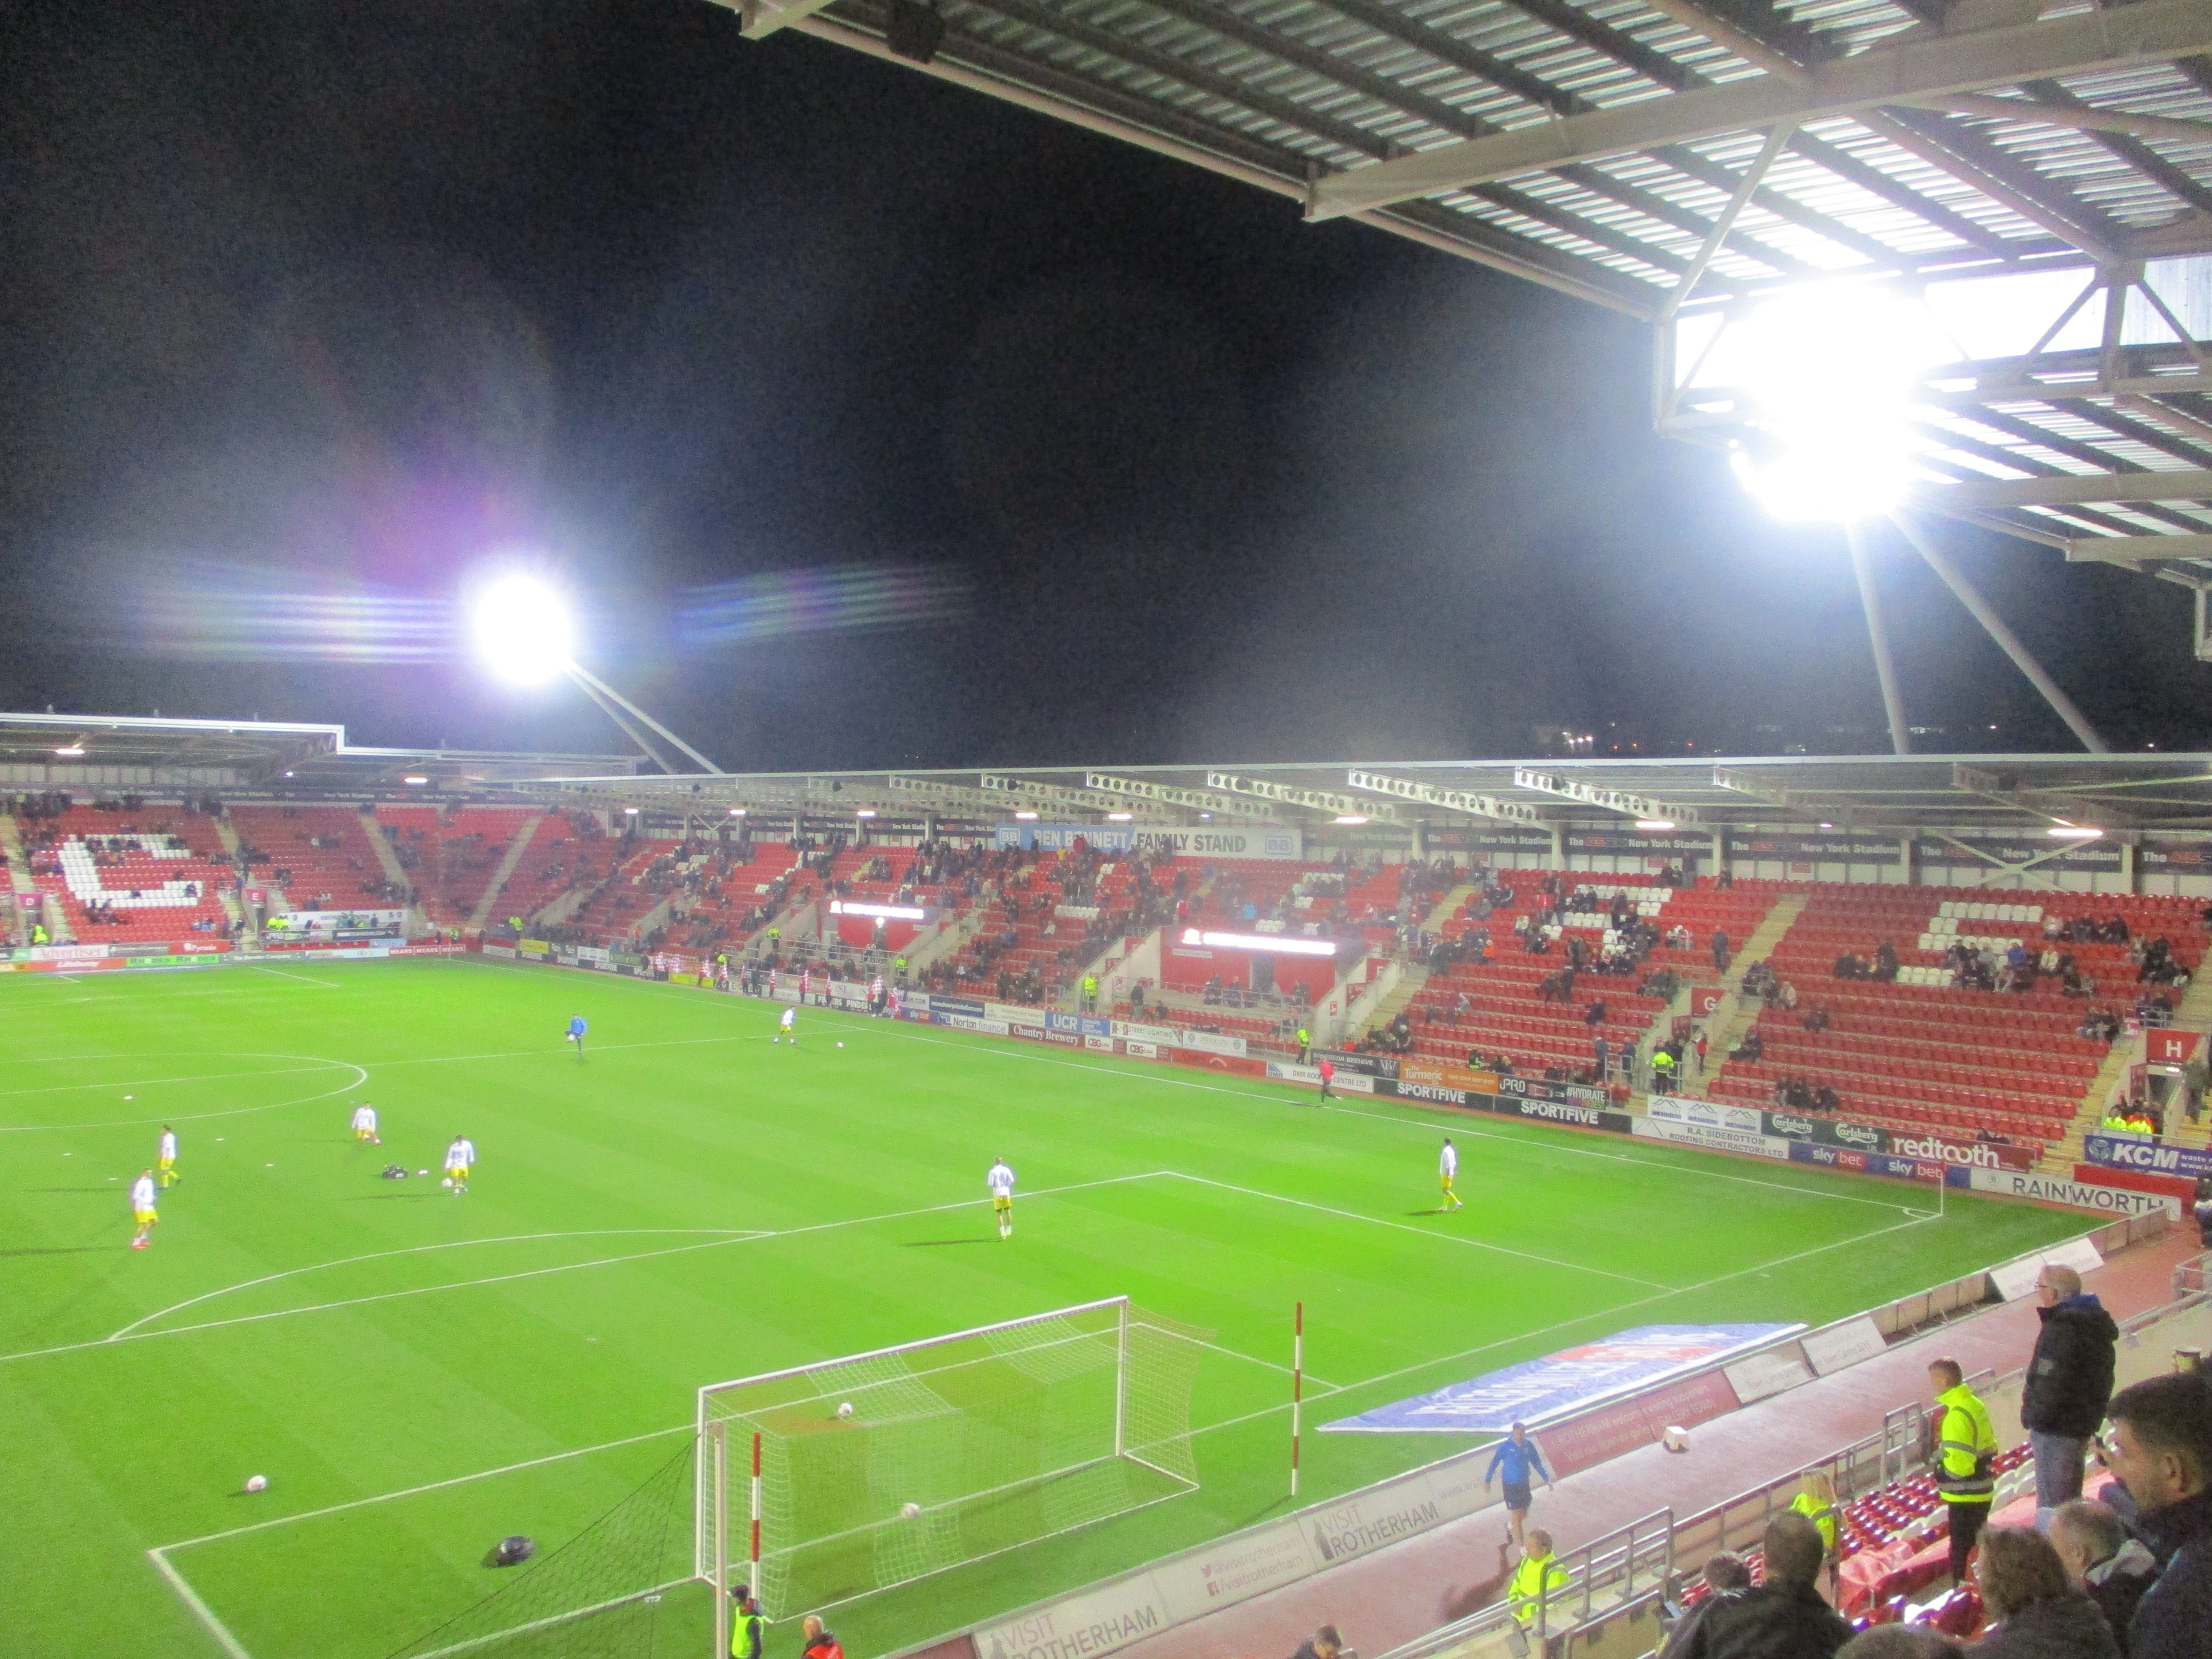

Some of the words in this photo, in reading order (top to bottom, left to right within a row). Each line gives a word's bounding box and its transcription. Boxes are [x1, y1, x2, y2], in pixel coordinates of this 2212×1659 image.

[1065, 831, 1127, 848] BNNETT
[1194, 835, 1246, 853] STAND
[1569, 837, 1584, 846] The
[1628, 839, 1648, 847] New
[1650, 839, 1671, 848] York
[1673, 840, 1713, 849] Stadium
[1921, 846, 1942, 856] The
[2002, 848, 2030, 858] New
[2143, 852, 2167, 863] The
[818, 996, 842, 1007] PINERS
[1704, 997, 1718, 1011] G
[910, 1010, 919, 1019] sky
[920, 1012, 930, 1020] bet
[1052, 1014, 1079, 1031] UCR
[953, 1017, 977, 1029] Norton
[978, 1021, 1006, 1033] finance
[1129, 1026, 1146, 1034] STREET
[1147, 1030, 1173, 1039] LIGHTING
[1013, 1025, 1044, 1040] Chantry
[1045, 1030, 1080, 1047] Brewery
[1130, 1044, 1144, 1054] CBG
[2165, 1039, 2182, 1059] H
[1346, 1057, 1374, 1066] BEEHIVE
[1292, 1070, 1306, 1078] DMR
[1334, 1076, 1355, 1086] CENTRE
[1404, 1068, 1443, 1081] Turmeric
[1397, 1082, 1466, 1104] SPORTFIVE
[1567, 1086, 1606, 1102] #HYDRATE
[1520, 1100, 1598, 1124] SPORTFIVE
[1772, 1114, 1813, 1133] Carlsberg
[1687, 1127, 1705, 1136] R.A.
[1707, 1128, 1766, 1145] SIDEBOTTOM
[1835, 1123, 1878, 1144] Carlsberg
[1670, 1133, 1704, 1144] ROOFING
[1706, 1139, 1766, 1154] CONTRACTORS
[1768, 1149, 1784, 1158] LTD
[1893, 1136, 2000, 1169] redtooth
[1813, 1149, 1835, 1164] sky
[1839, 1152, 1862, 1167] bet
[2112, 1142, 2180, 1170] KCM
[1889, 1160, 1913, 1176] sky
[1917, 1163, 1944, 1179] bet
[2012, 1177, 2163, 1214] RAINWORTH
[1557, 1417, 1611, 1446] ROTHERHAM
[1321, 1503, 1363, 1534] VISIT
[1331, 1501, 1439, 1557] ROTHERHAM
[1002, 1613, 1054, 1650] VISIT
